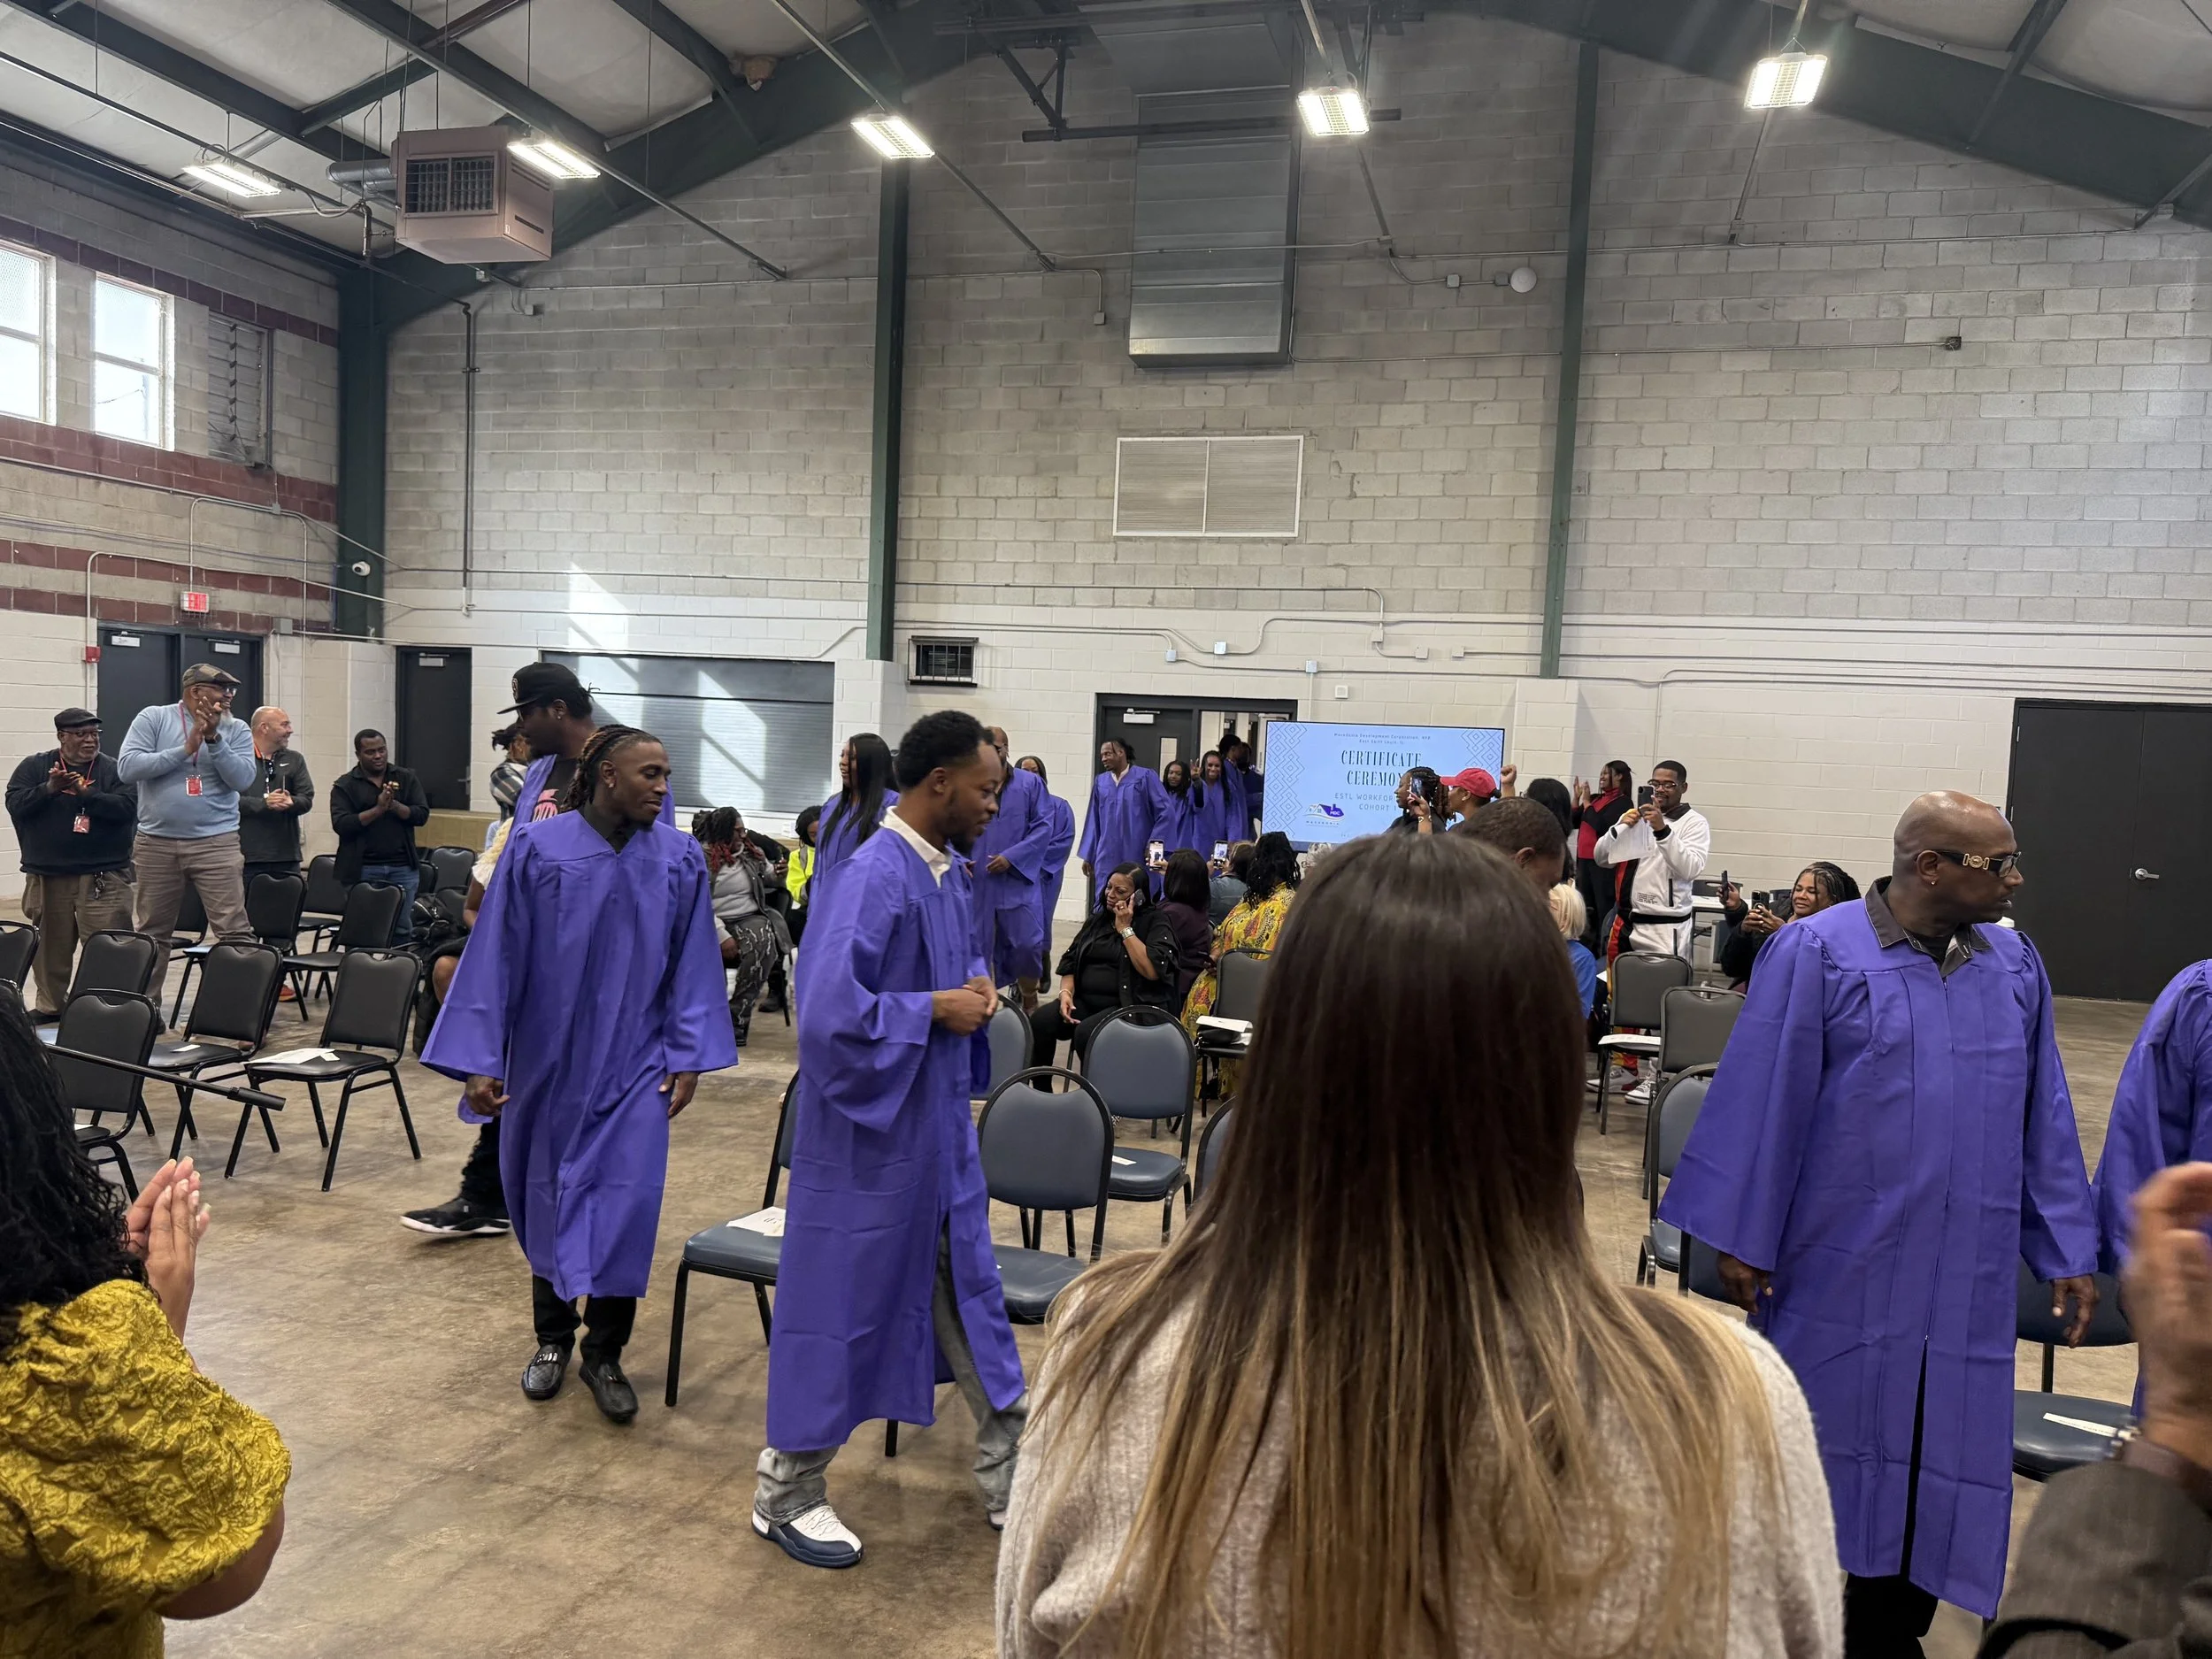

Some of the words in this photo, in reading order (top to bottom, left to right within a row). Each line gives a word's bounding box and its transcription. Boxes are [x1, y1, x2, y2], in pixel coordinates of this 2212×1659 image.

[1341, 749, 1422, 768] CERTIFICATE
[1347, 771, 1402, 787] CEREMO
[1356, 794, 1395, 803] WORKFOR
